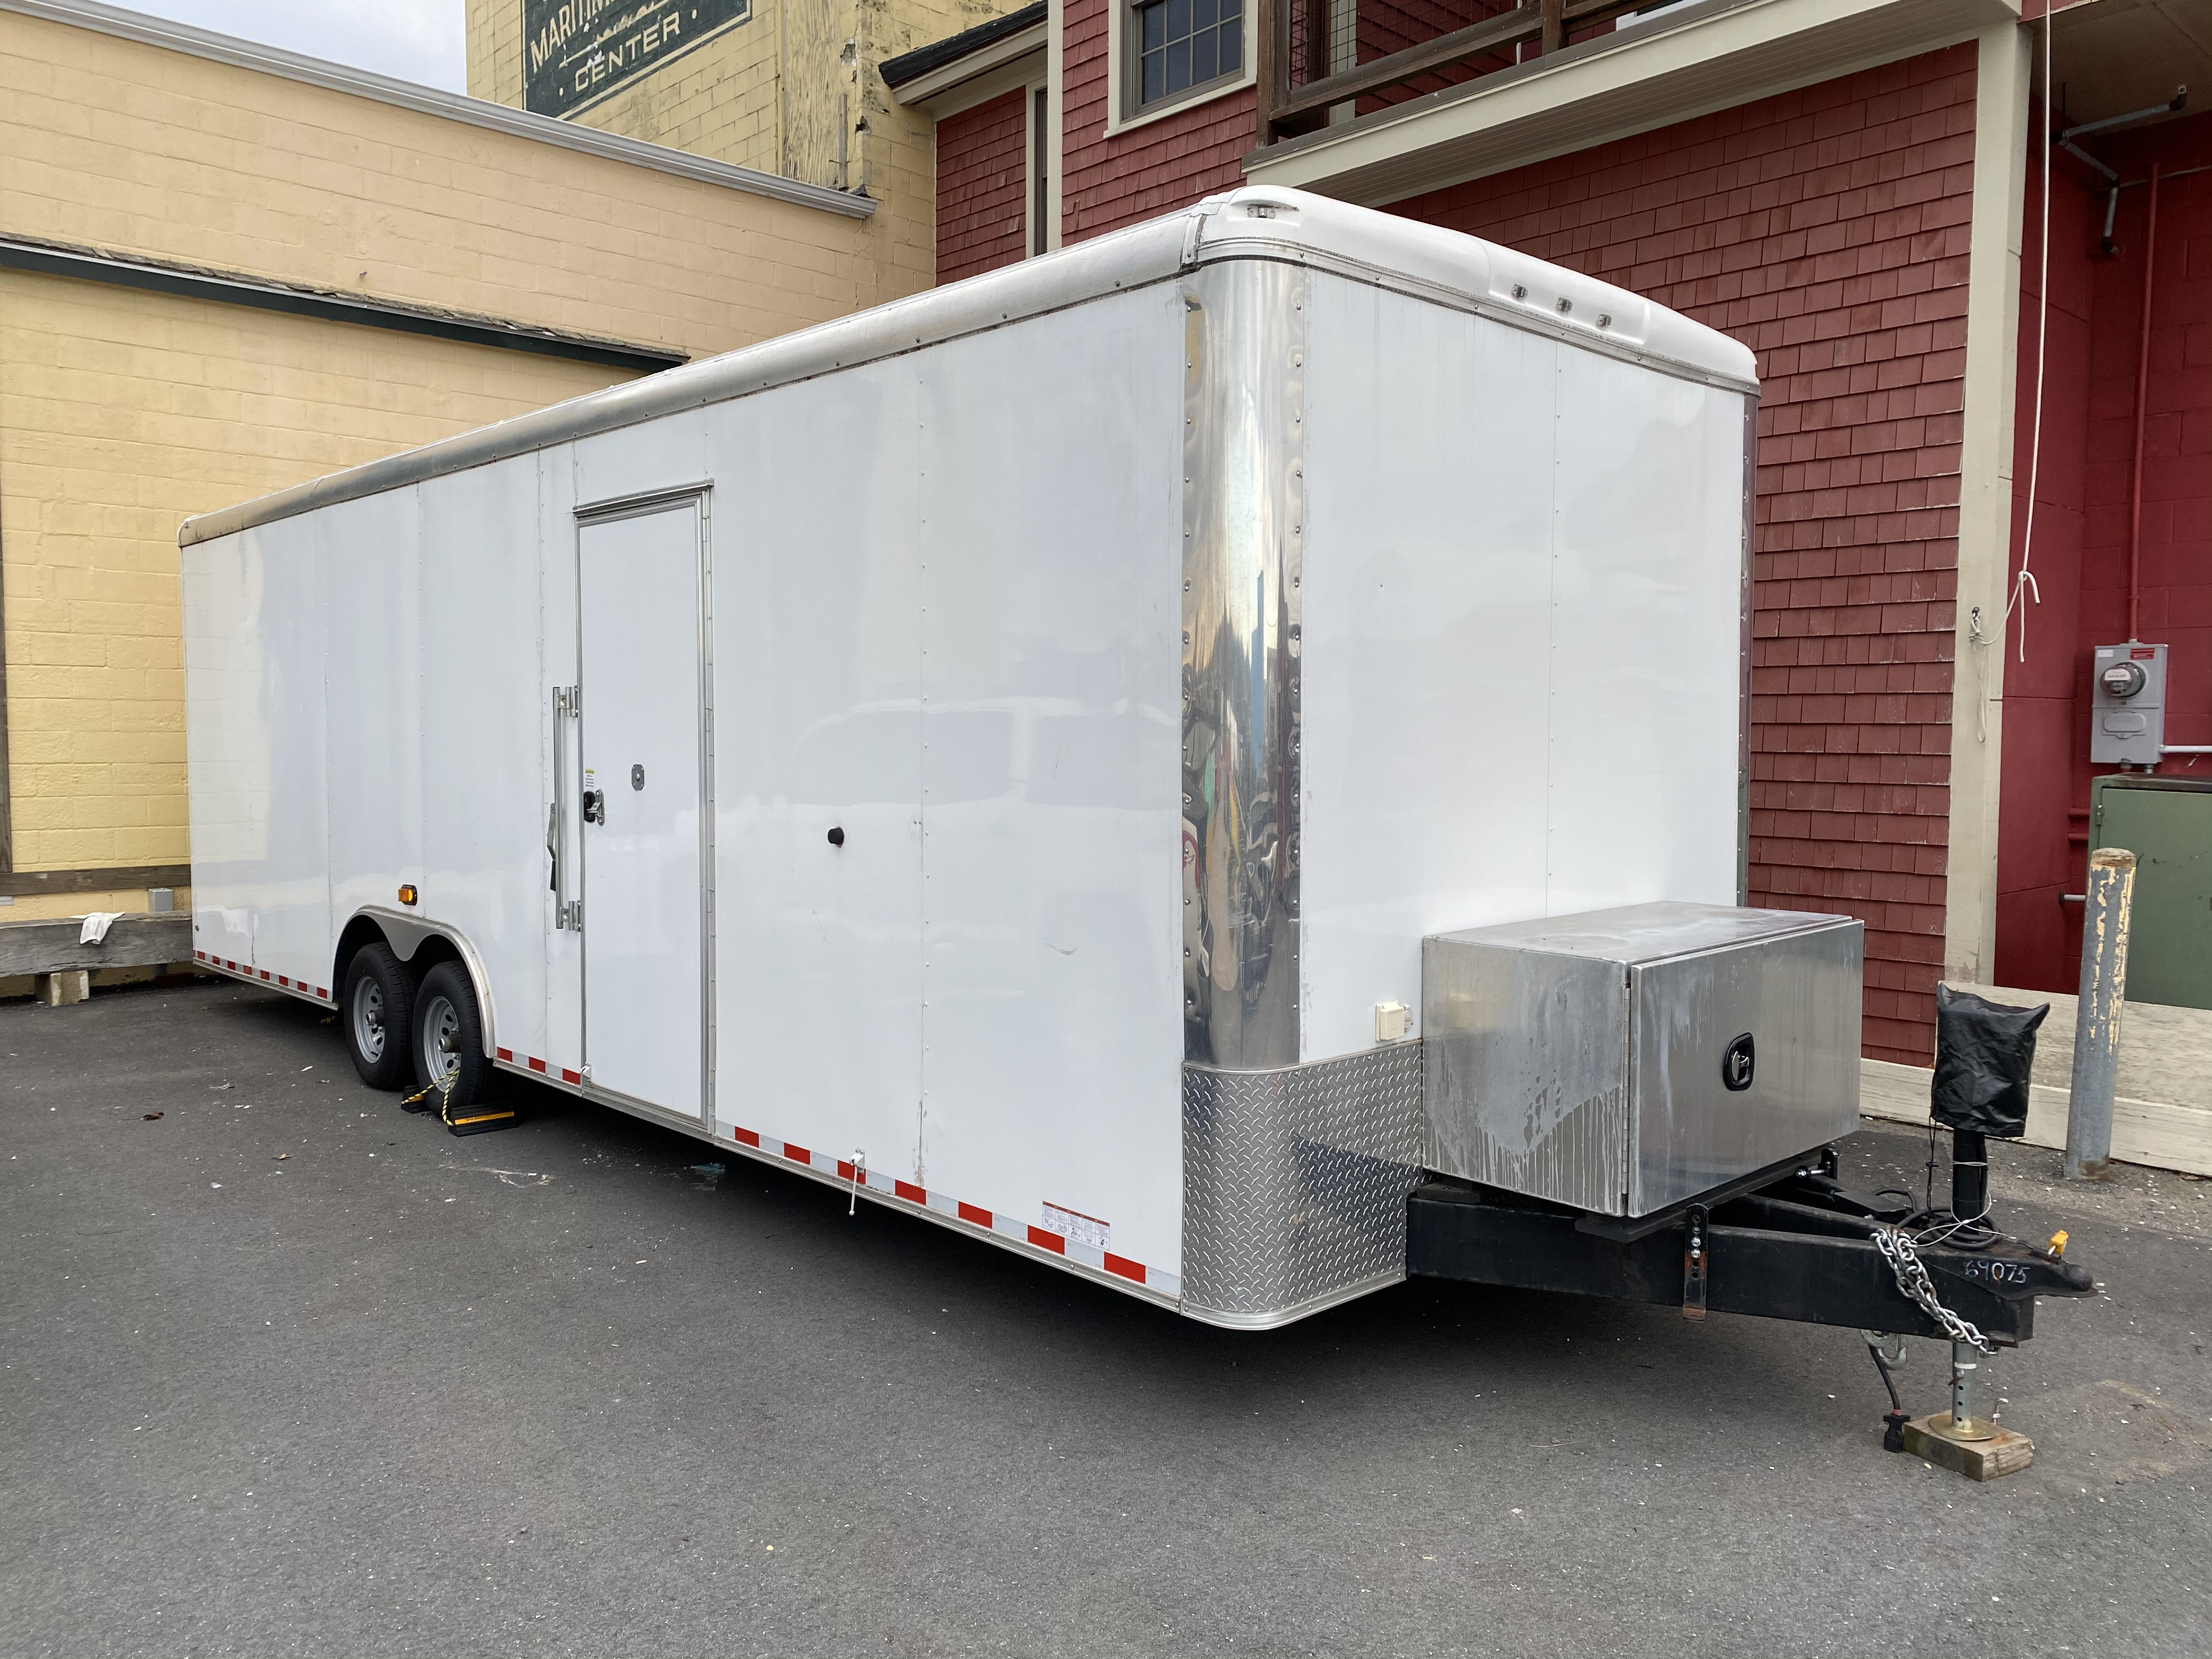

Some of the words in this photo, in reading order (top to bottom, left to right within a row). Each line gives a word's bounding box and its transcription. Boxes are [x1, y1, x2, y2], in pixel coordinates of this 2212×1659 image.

[530, 0, 615, 74] MARITI
[575, 11, 680, 92] CENTER
[1965, 1260, 2031, 1284] 69075
